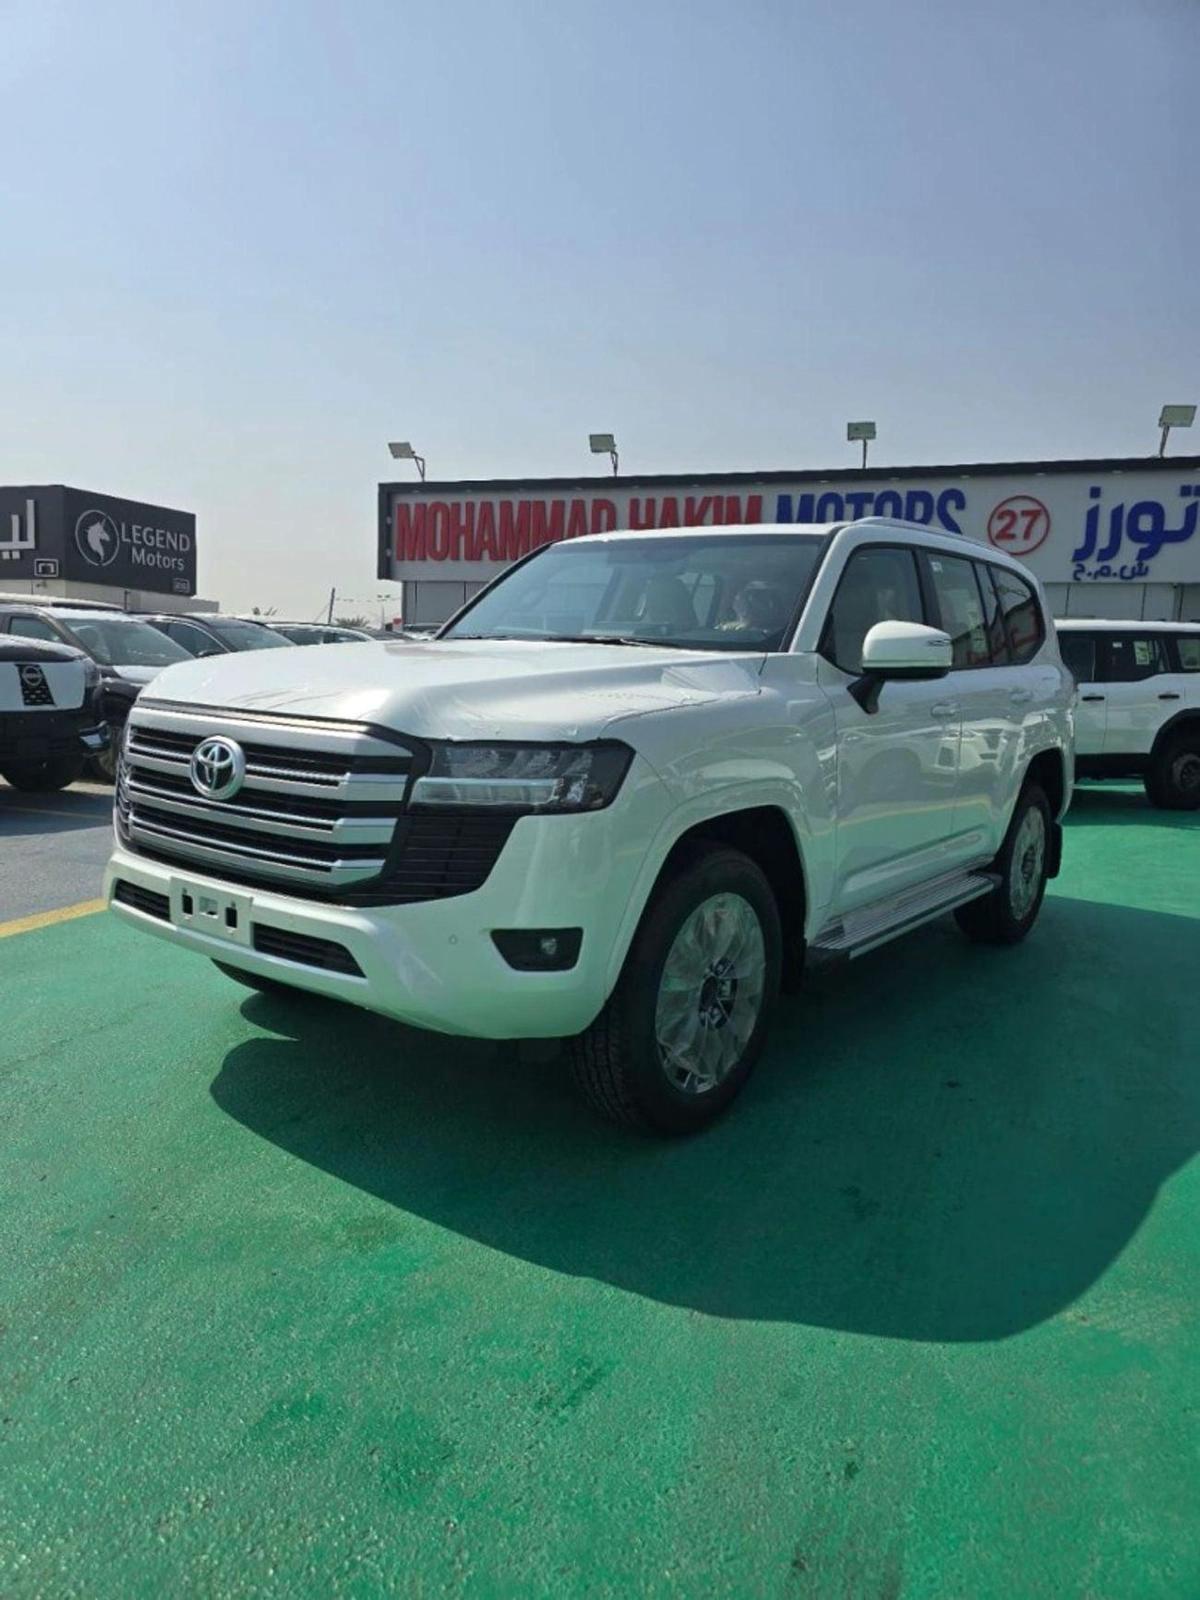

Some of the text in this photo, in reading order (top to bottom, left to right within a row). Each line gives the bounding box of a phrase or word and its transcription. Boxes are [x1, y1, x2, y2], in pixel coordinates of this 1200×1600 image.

[121, 522, 190, 552] LEGEND
[395, 498, 616, 561] MOHAMMAD
[995, 509, 1043, 541] 27
[131, 546, 185, 571] Motors
